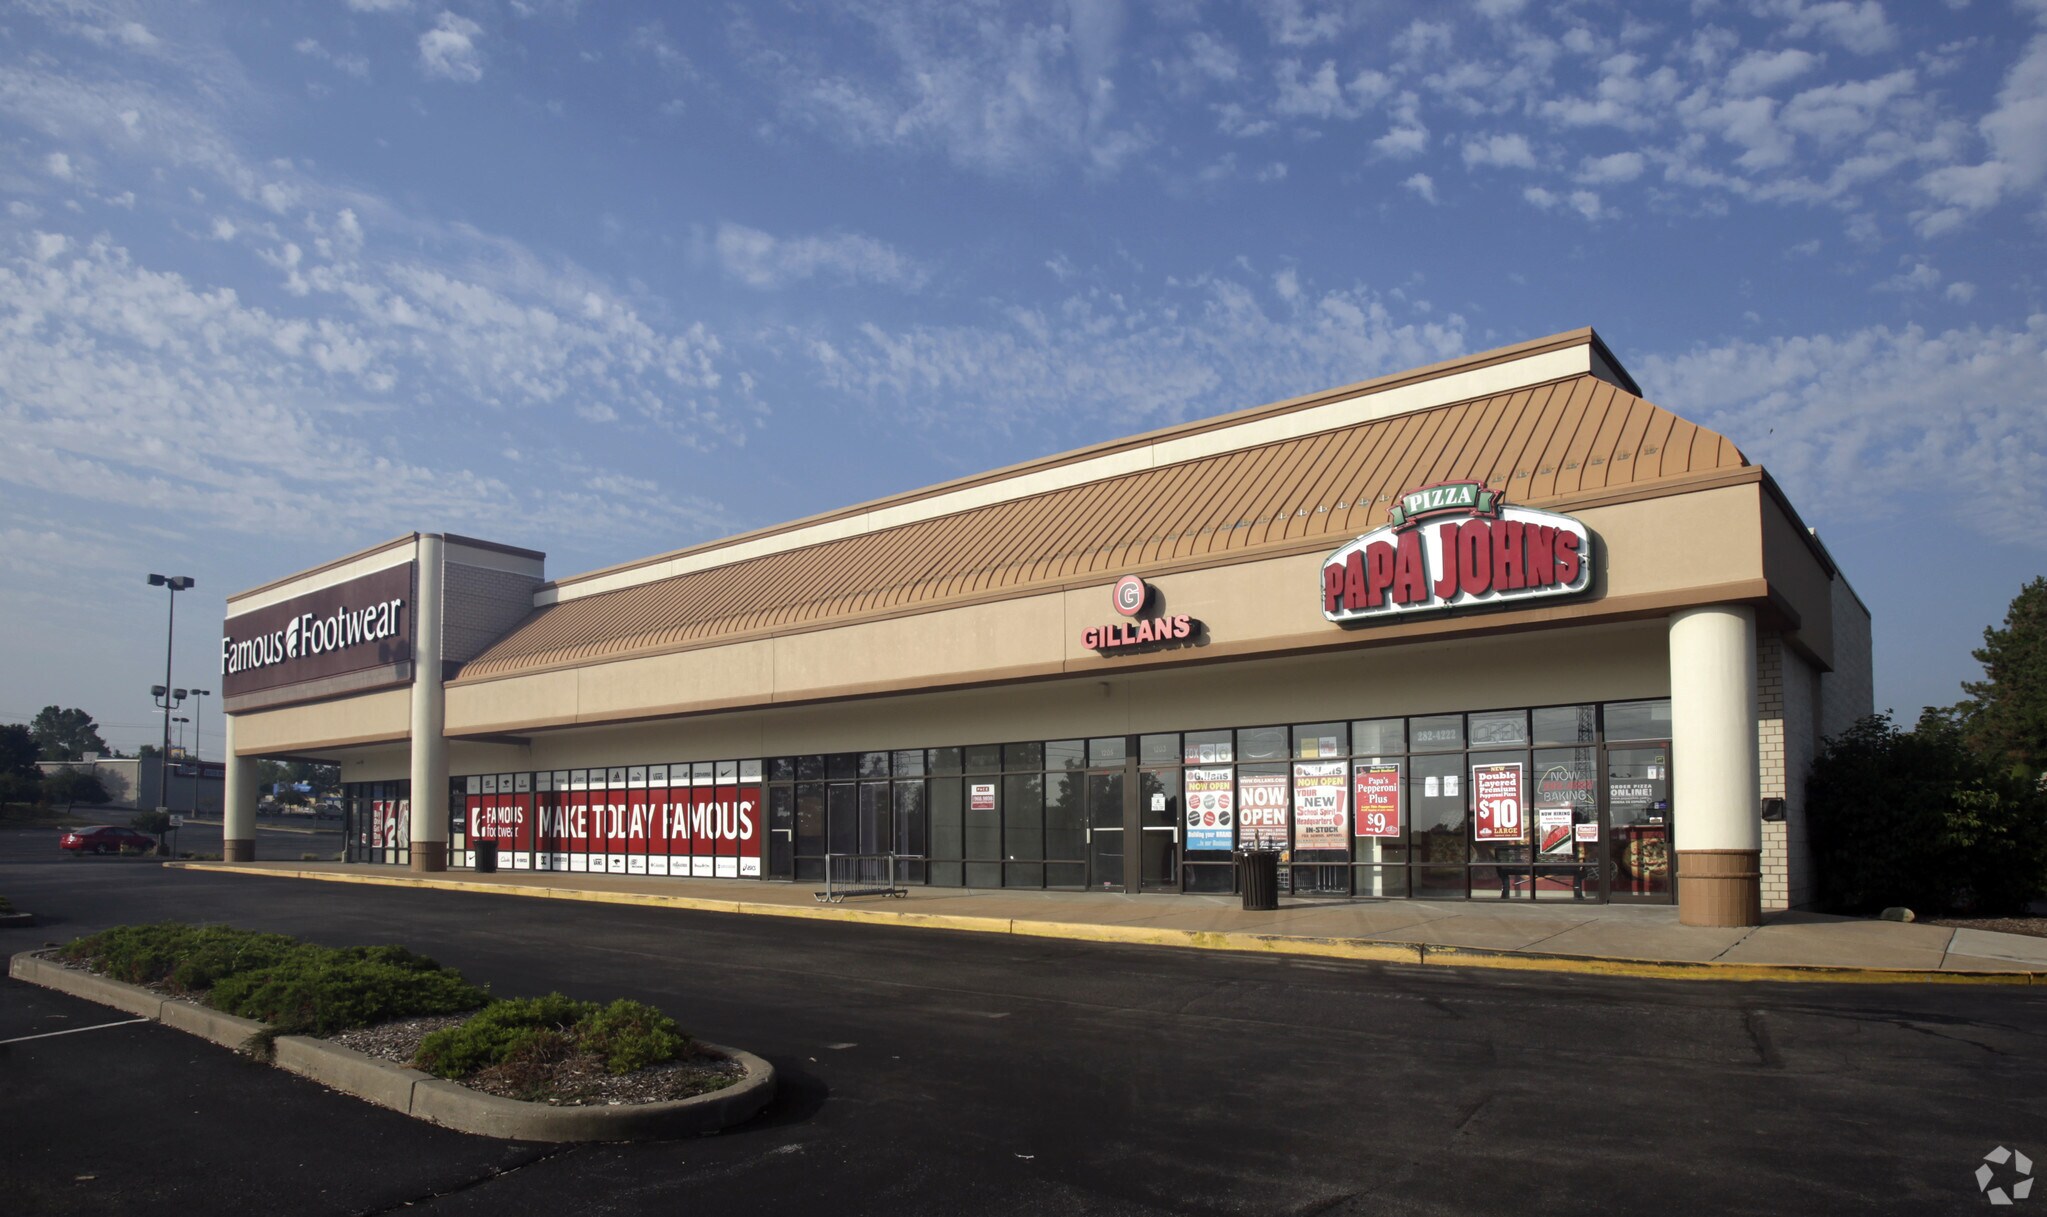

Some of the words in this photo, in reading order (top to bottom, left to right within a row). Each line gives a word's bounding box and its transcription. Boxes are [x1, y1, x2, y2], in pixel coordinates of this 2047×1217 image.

[1410, 486, 1472, 512] PIZZA
[1324, 530, 1429, 612] PAPA
[1118, 581, 1140, 610] G
[221, 631, 283, 675] Famous
[300, 598, 401, 657] Footwear
[1081, 615, 1190, 650] GILLANS
[1368, 777, 1389, 786] Papa's
[1478, 772, 1517, 780] Double
[1550, 771, 1581, 781] NOW
[1189, 782, 1207, 791] NOW
[1209, 781, 1230, 790] OPEN
[1298, 778, 1318, 787] NOW
[1320, 777, 1344, 786] OPEN
[1479, 779, 1517, 789] Layered
[1297, 789, 1316, 797] YOUR
[1357, 783, 1398, 794] Pepperoni
[1610, 788, 1652, 796] ONLINE!
[1241, 786, 1285, 806] NOW
[1304, 796, 1335, 807] NEW
[1369, 794, 1388, 803] Plus
[1543, 790, 1587, 802] BAKING
[486, 806, 523, 824] FAMOUS
[1297, 805, 1319, 816] School
[1320, 808, 1335, 816] Spirit
[1479, 799, 1518, 828] $10
[539, 804, 587, 838] MAKE
[592, 803, 656, 839] TODAY
[662, 800, 753, 840] FAMOUS
[1240, 808, 1286, 826] OPEN
[1297, 817, 1332, 826] Headquarters
[1367, 813, 1386, 834] $9
[487, 823, 519, 838] footwear
